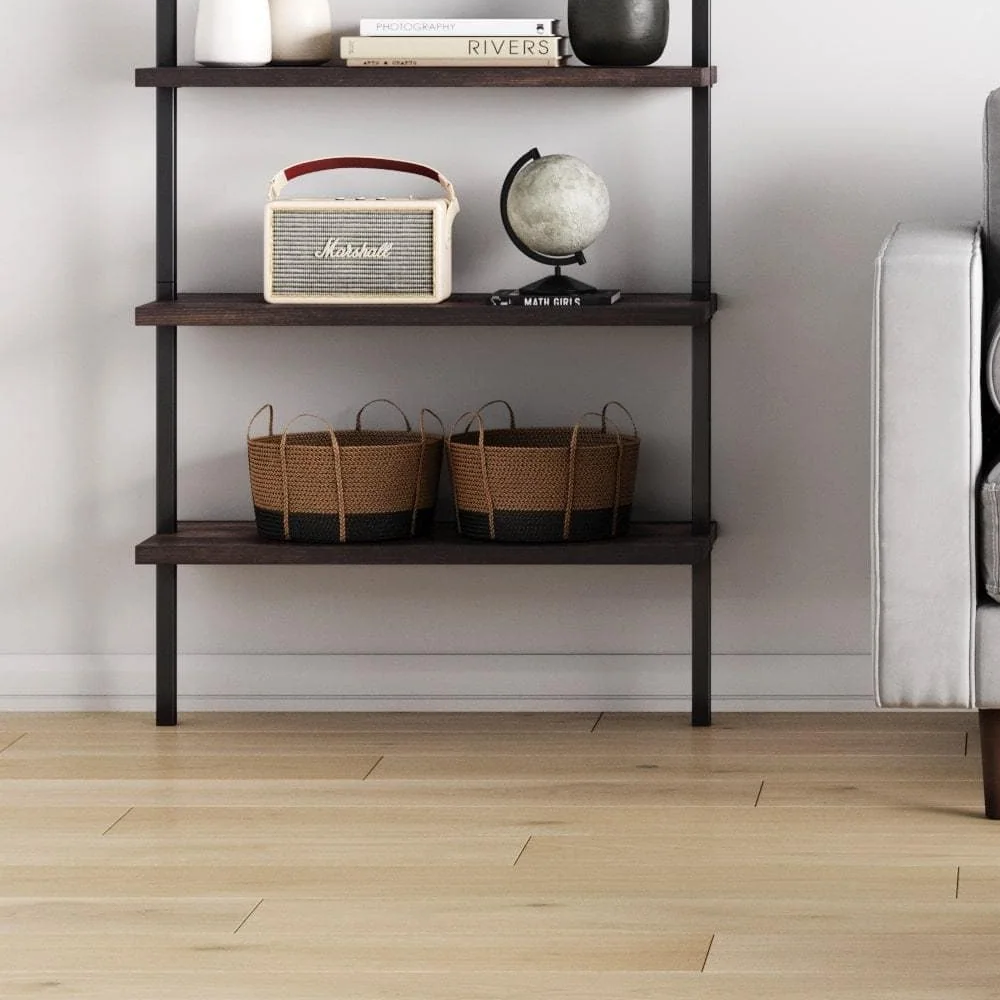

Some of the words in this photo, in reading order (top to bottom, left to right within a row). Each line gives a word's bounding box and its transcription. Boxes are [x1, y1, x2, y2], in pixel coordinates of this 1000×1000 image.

[376, 23, 456, 32] PHOTOGRAPHY
[468, 40, 549, 55] RIVERS
[314, 237, 393, 258] Marshall
[524, 297, 549, 306] MATH
[553, 297, 581, 306] GIRLS
